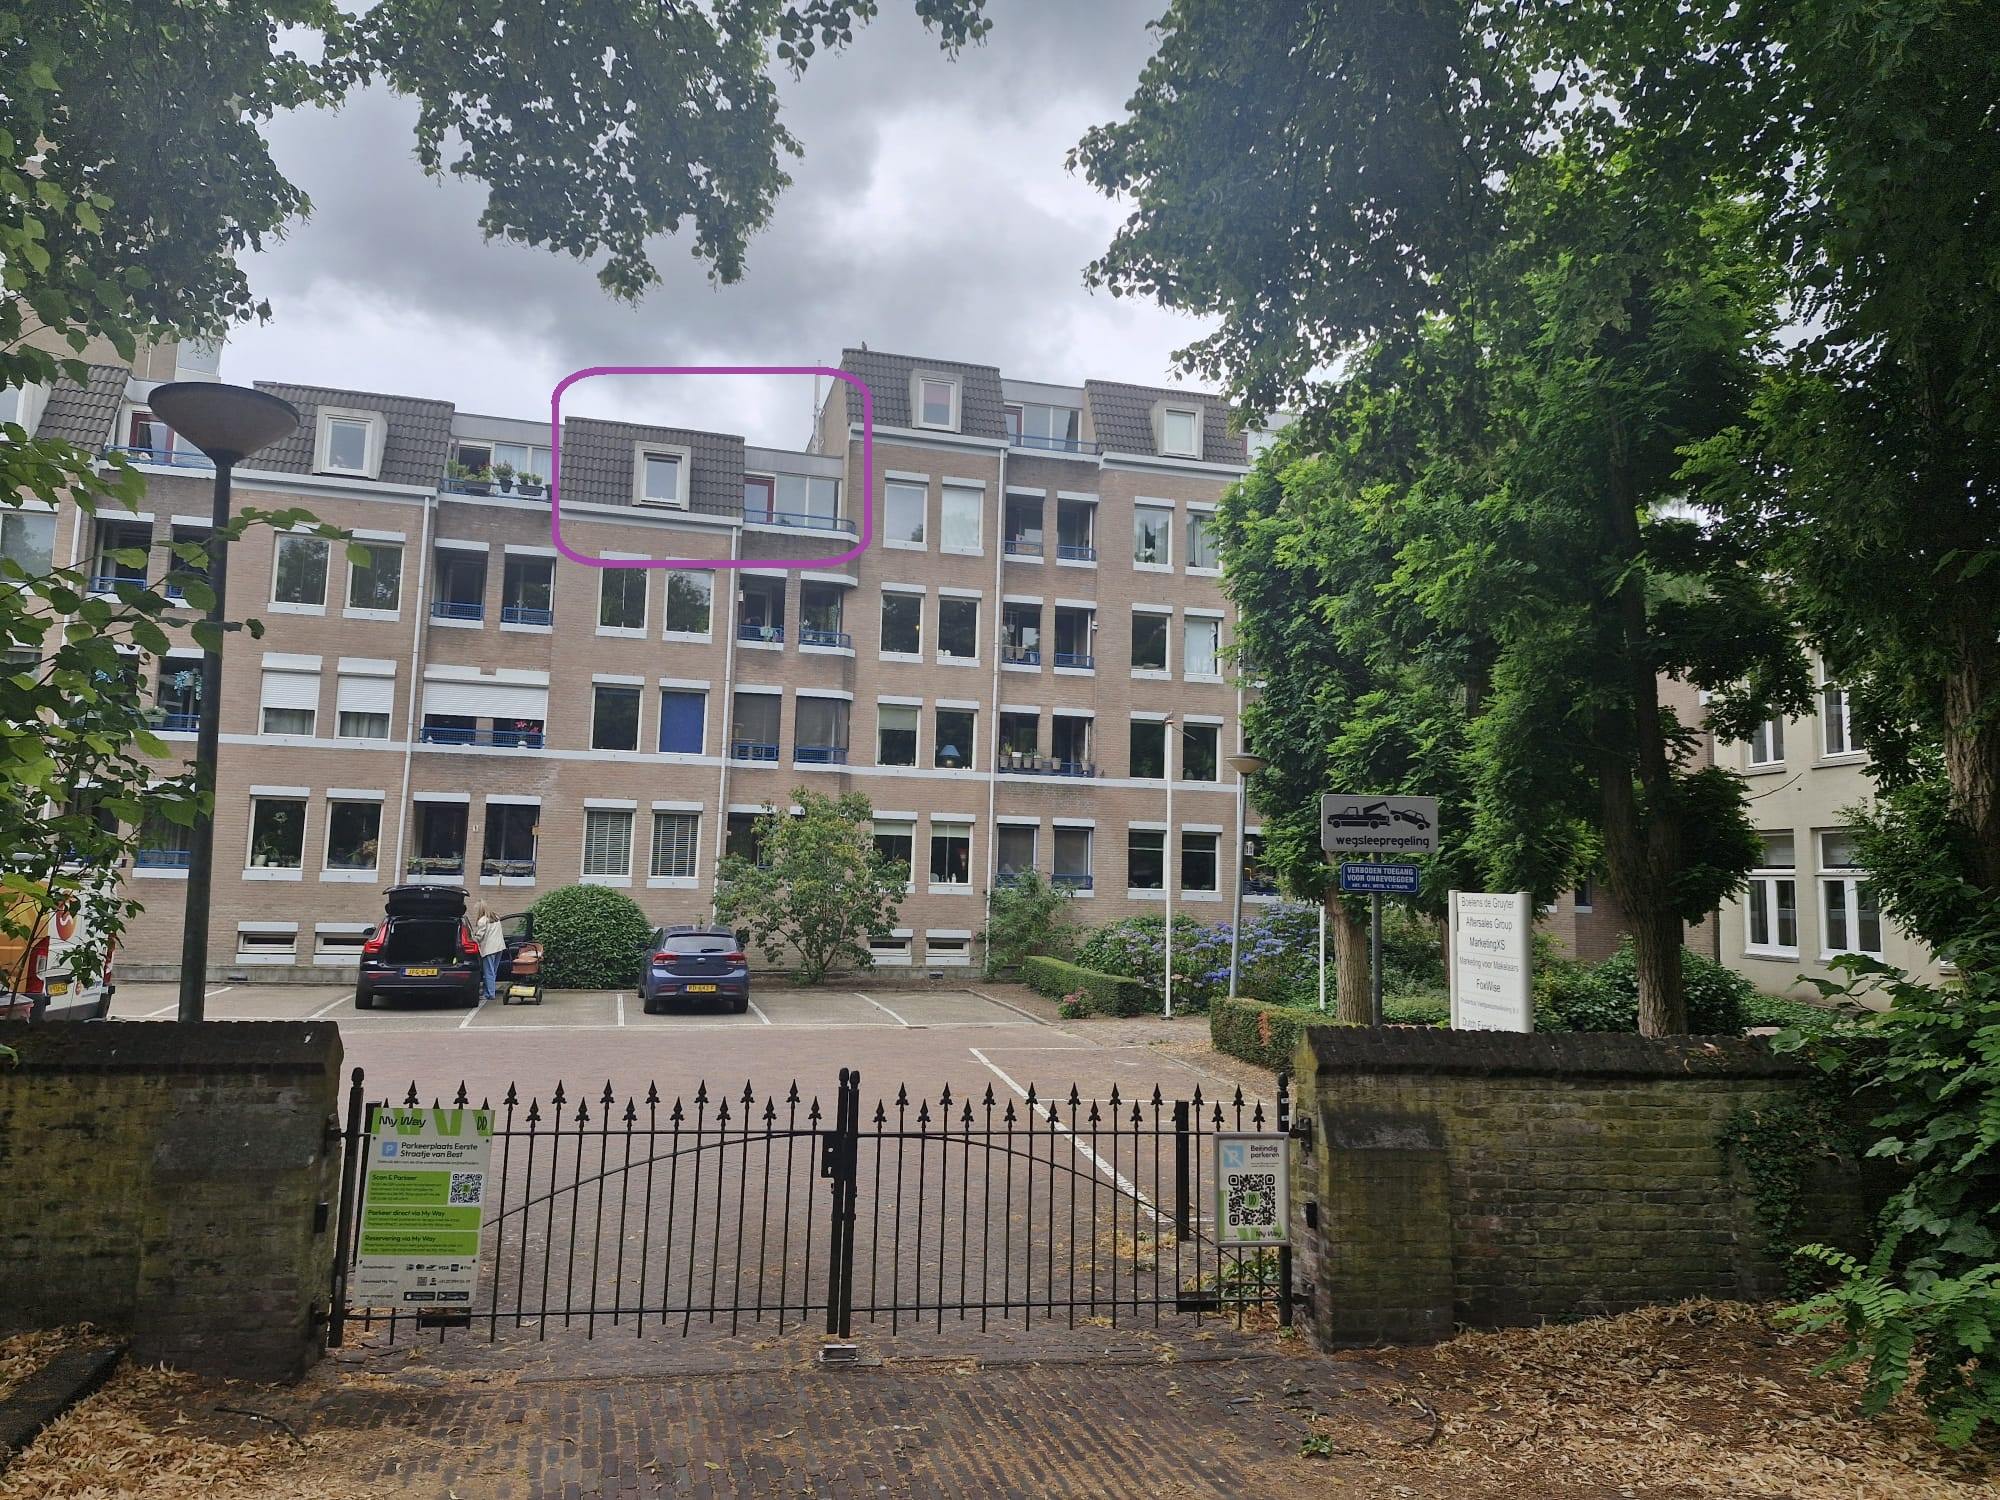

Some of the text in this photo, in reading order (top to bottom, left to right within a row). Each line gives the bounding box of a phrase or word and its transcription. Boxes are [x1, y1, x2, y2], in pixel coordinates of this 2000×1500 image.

[1335, 835, 1430, 848] wegsleepregeling
[1347, 866, 1413, 875] VERBODEN TOEGANG
[1366, 875, 1414, 883] ONBEVOEGDEN
[1461, 896, 1515, 911] Boelens de Gruyter
[1466, 916, 1513, 932] Aftersales Group
[1469, 936, 1506, 952] MarketingXS
[1460, 956, 1481, 969] Marketing
[1482, 960, 1493, 968] voor
[1476, 978, 1501, 992] FoxWise
[379, 1115, 426, 1127] My Way
[401, 1142, 453, 1150] Parkeerplaats
[400, 1150, 430, 1158] Straatje
